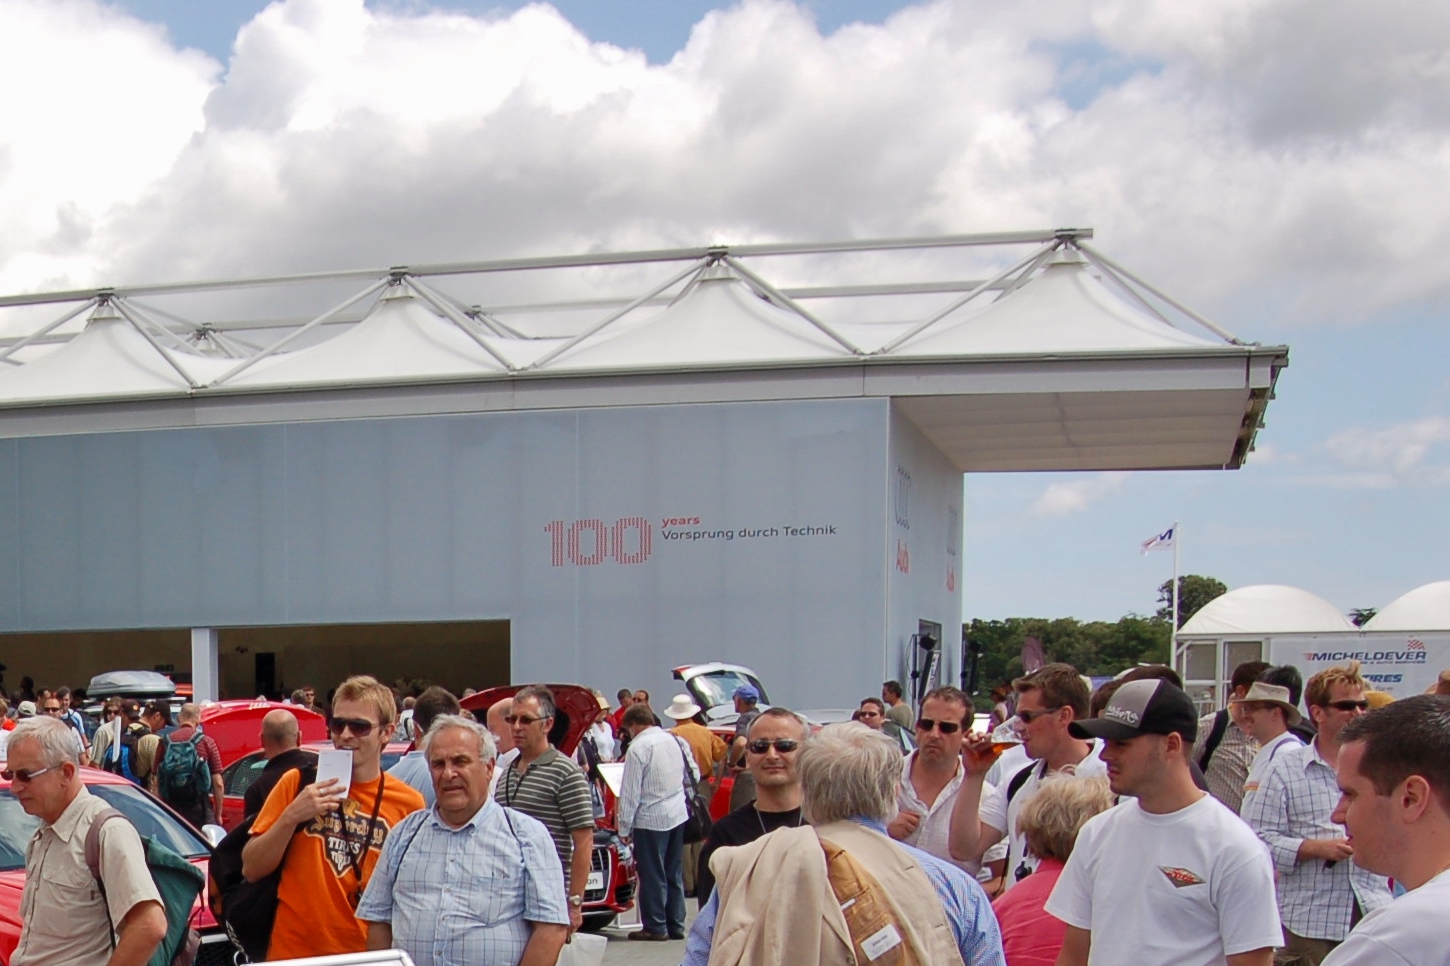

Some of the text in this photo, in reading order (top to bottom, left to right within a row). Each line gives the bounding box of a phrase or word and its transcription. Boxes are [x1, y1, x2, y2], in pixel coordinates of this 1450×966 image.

[662, 515, 700, 527] years
[661, 525, 838, 541] Vorsprung durch Technik
[544, 516, 652, 567] 100
[1312, 651, 1427, 661] MICHELDEVER
